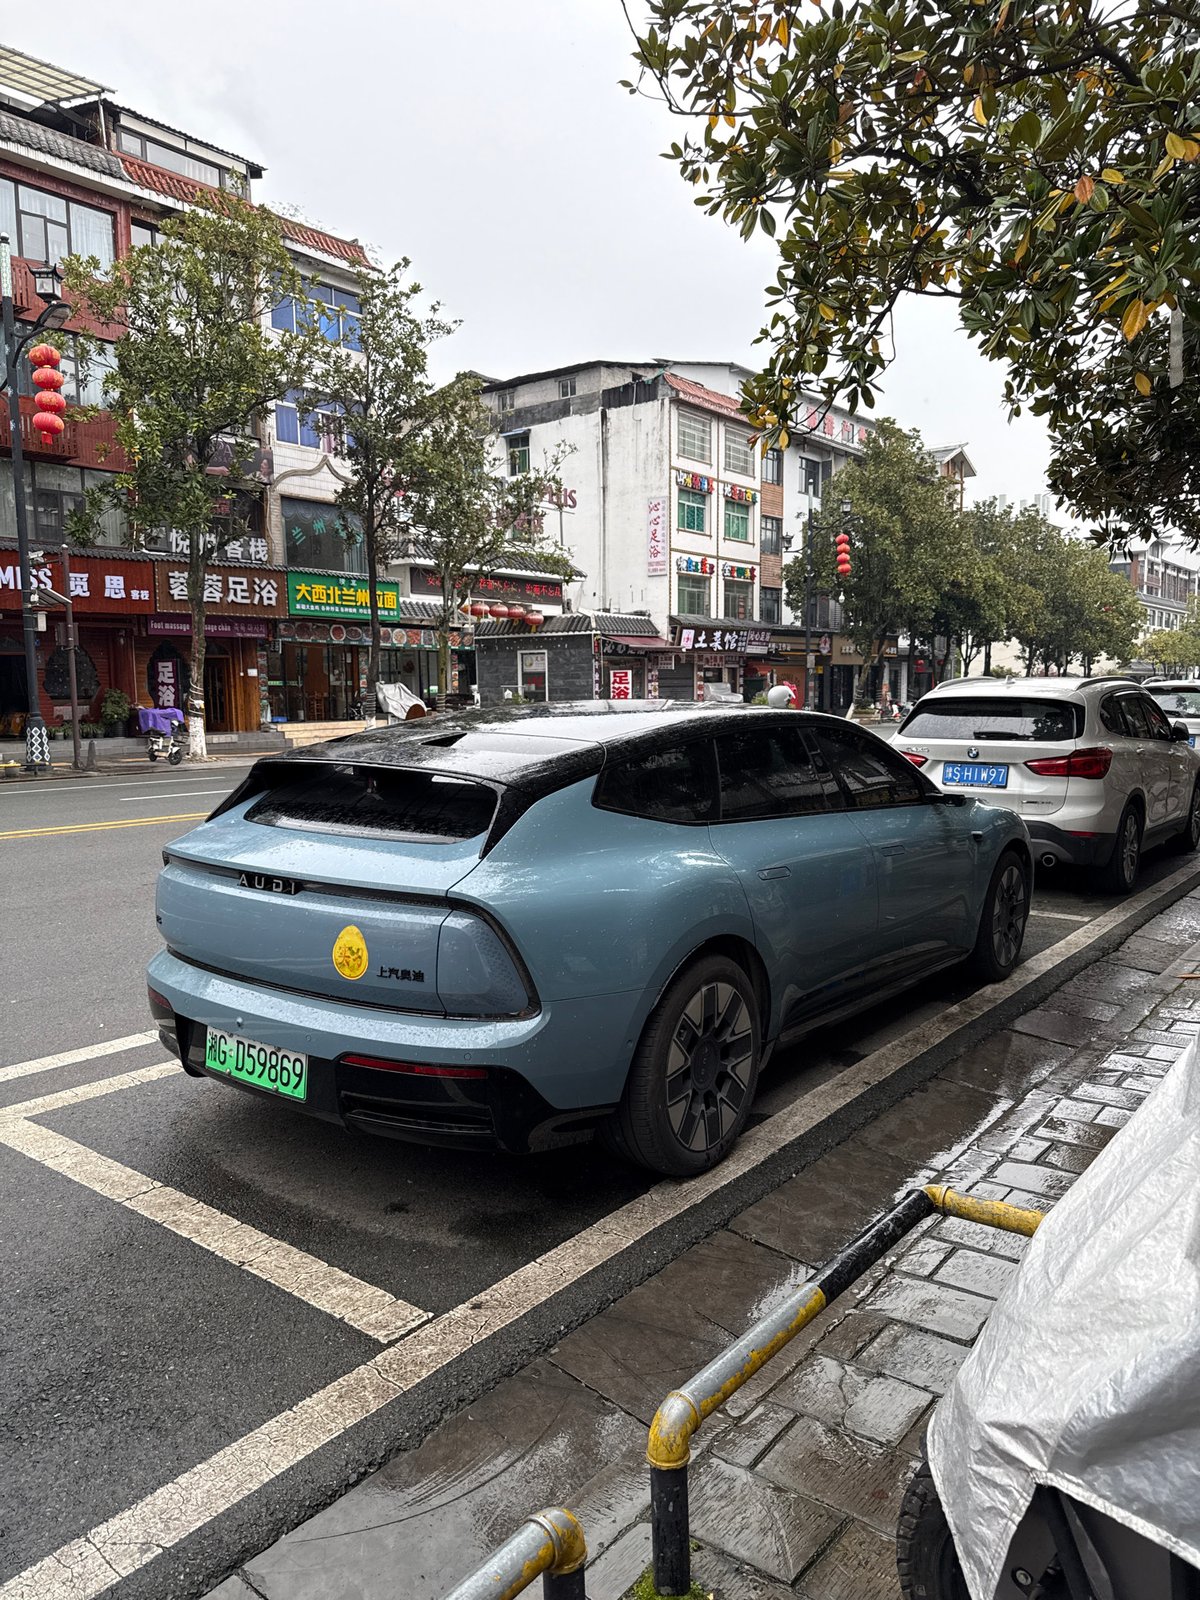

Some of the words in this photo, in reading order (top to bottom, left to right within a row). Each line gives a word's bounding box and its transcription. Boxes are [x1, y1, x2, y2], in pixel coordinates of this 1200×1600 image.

[168, 571, 278, 607] 蓉蓉足浴
[151, 620, 164, 630] Foot
[165, 622, 191, 632] massage
[204, 624, 217, 633] sage
[695, 630, 739, 651] 土菜馆
[157, 661, 176, 707] 足浴
[611, 671, 630, 700] 足浴
[239, 874, 295, 895] AUDI
[376, 966, 424, 983] 上汽奥迪
